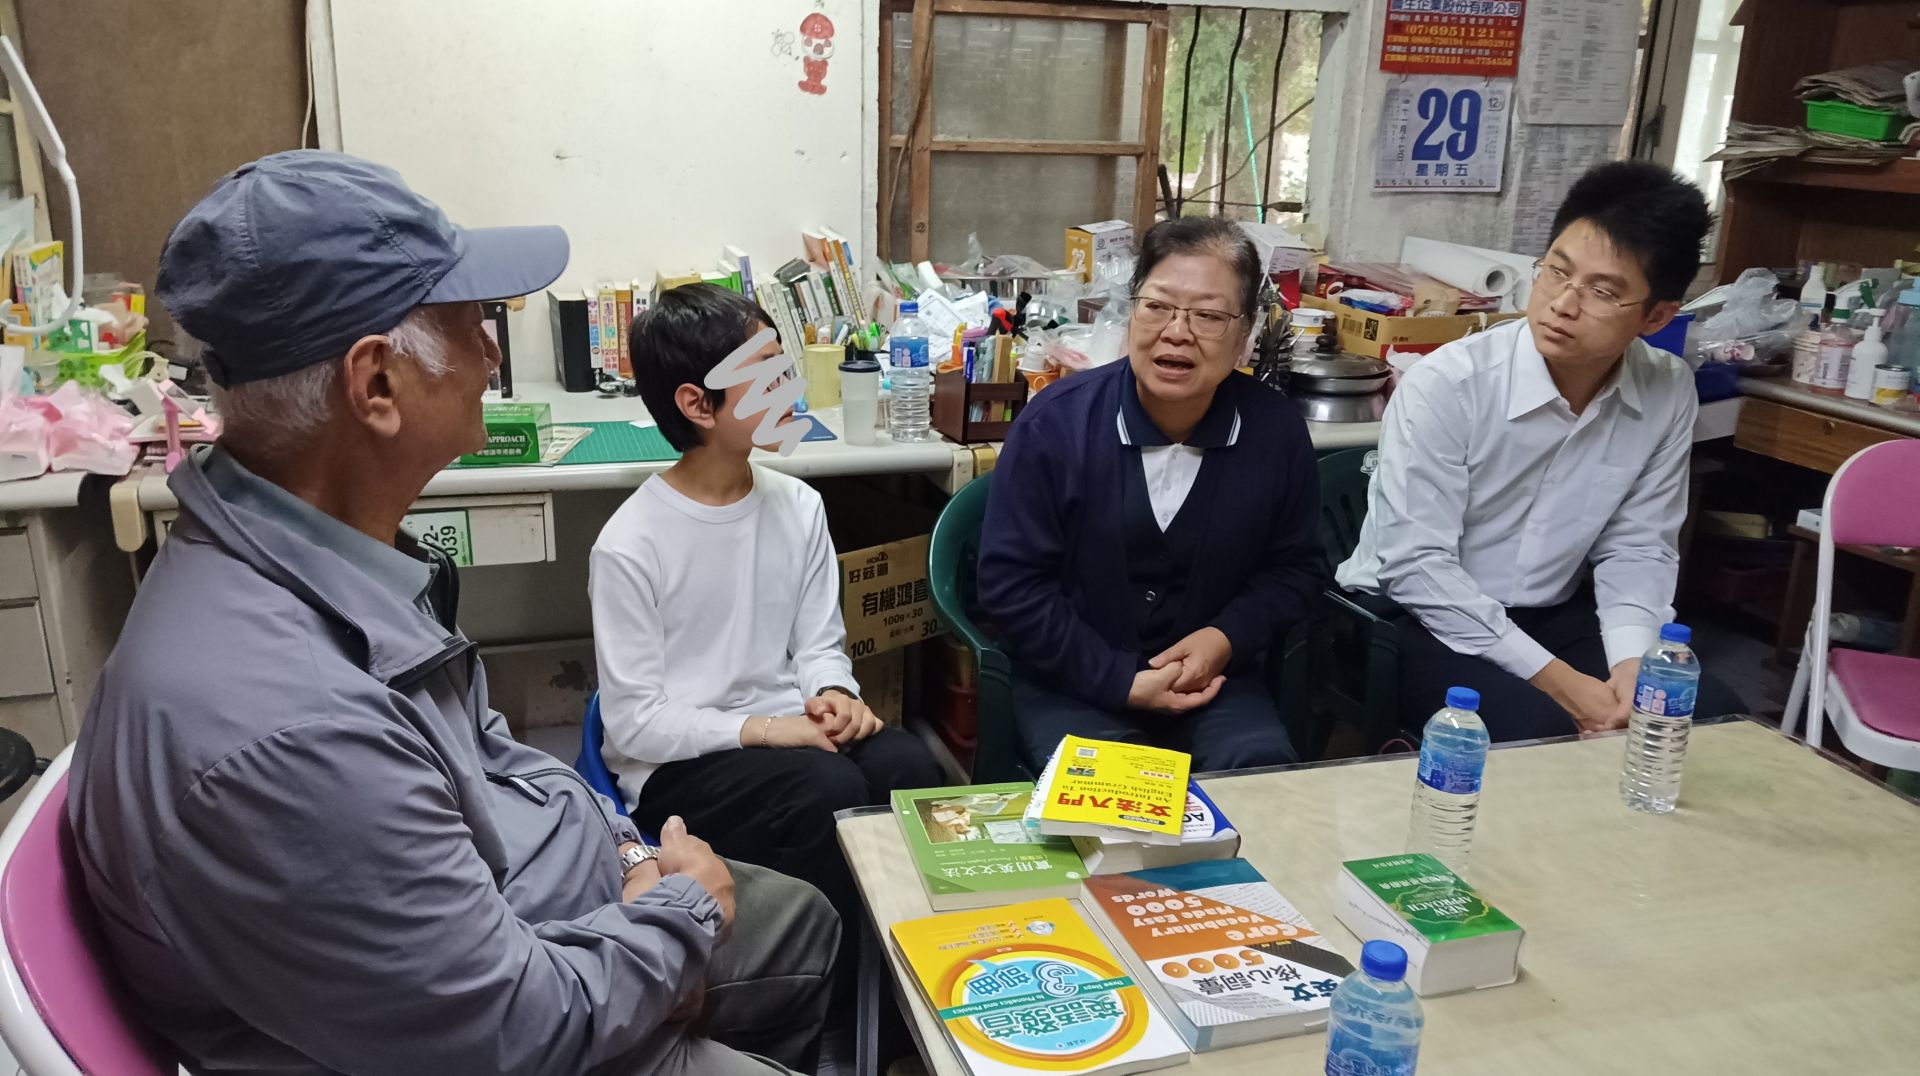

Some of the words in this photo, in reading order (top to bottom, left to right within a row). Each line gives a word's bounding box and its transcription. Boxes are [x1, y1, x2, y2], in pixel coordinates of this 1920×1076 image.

[1405, 24, 1495, 38] (07)6951121
[1412, 88, 1482, 161] 29
[1416, 163, 1469, 177] 星期五
[488, 435, 526, 443] APPROACH
[1071, 779, 1122, 790] Grammar
[1126, 785, 1173, 797] English
[1079, 786, 1151, 801] Introduction
[1154, 794, 1170, 803] An
[1058, 792, 1173, 818] 文法入門
[1111, 888, 1179, 904] Words
[1126, 895, 1203, 917] 5000
[1406, 896, 1473, 912] APPROACH
[1433, 904, 1470, 917] NEW
[1133, 911, 1180, 927] Easy
[1183, 906, 1236, 920] Made
[1151, 913, 1265, 938] Vocabulary
[1225, 923, 1299, 941] Core
[1162, 950, 1265, 979] 5000
[1082, 982, 1103, 991] Steps
[1103, 980, 1125, 988] Three
[1193, 964, 1302, 996] 核心詞彙
[1283, 978, 1338, 1002] 英文
[983, 1001, 1000, 1010] and
[1000, 995, 1036, 1006] Phonetics
[952, 1004, 983, 1015] Phonics
[983, 998, 1126, 1039] 英語發音
